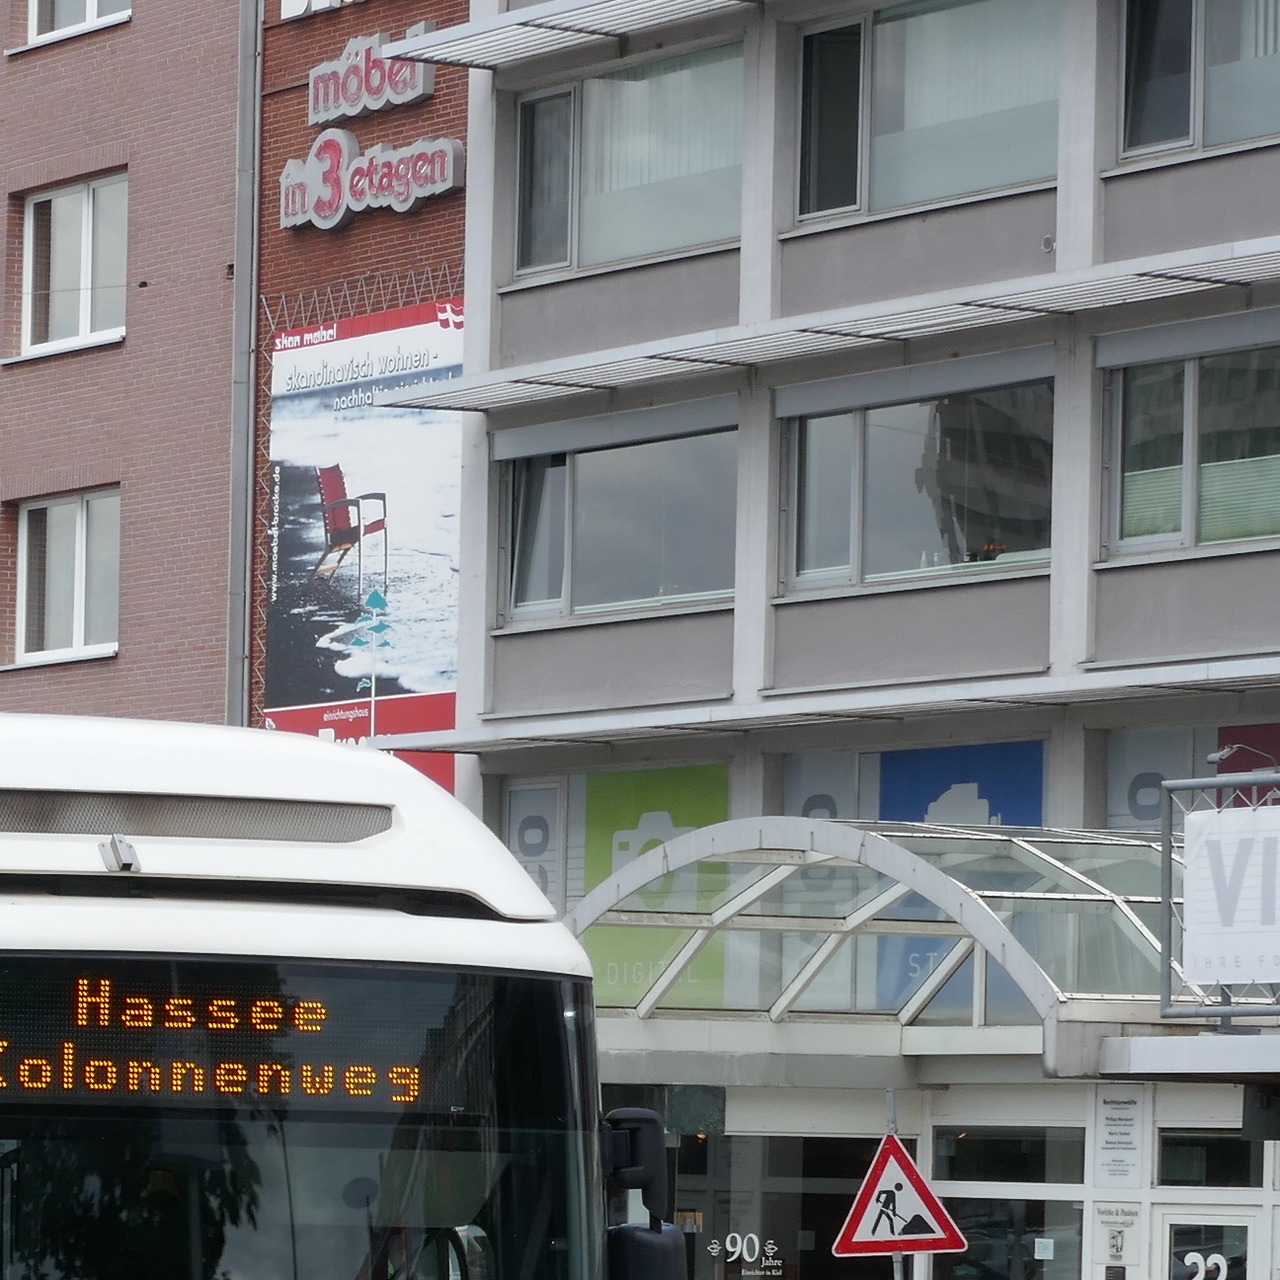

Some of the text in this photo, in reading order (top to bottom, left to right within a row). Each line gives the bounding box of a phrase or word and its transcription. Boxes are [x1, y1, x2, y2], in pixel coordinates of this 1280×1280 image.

[312, 46, 420, 113] möbel
[283, 138, 448, 219] in 3 etagen
[274, 333, 301, 351] skan
[285, 352, 374, 392] skandinavisch
[378, 346, 430, 375] wohnen
[323, 706, 369, 723] einrichtungshaus
[607, 961, 699, 985] DIGITL
[76, 979, 328, 1032] Hassee
[725, 1233, 760, 1263] 90
[761, 1257, 783, 1268] Jahre
